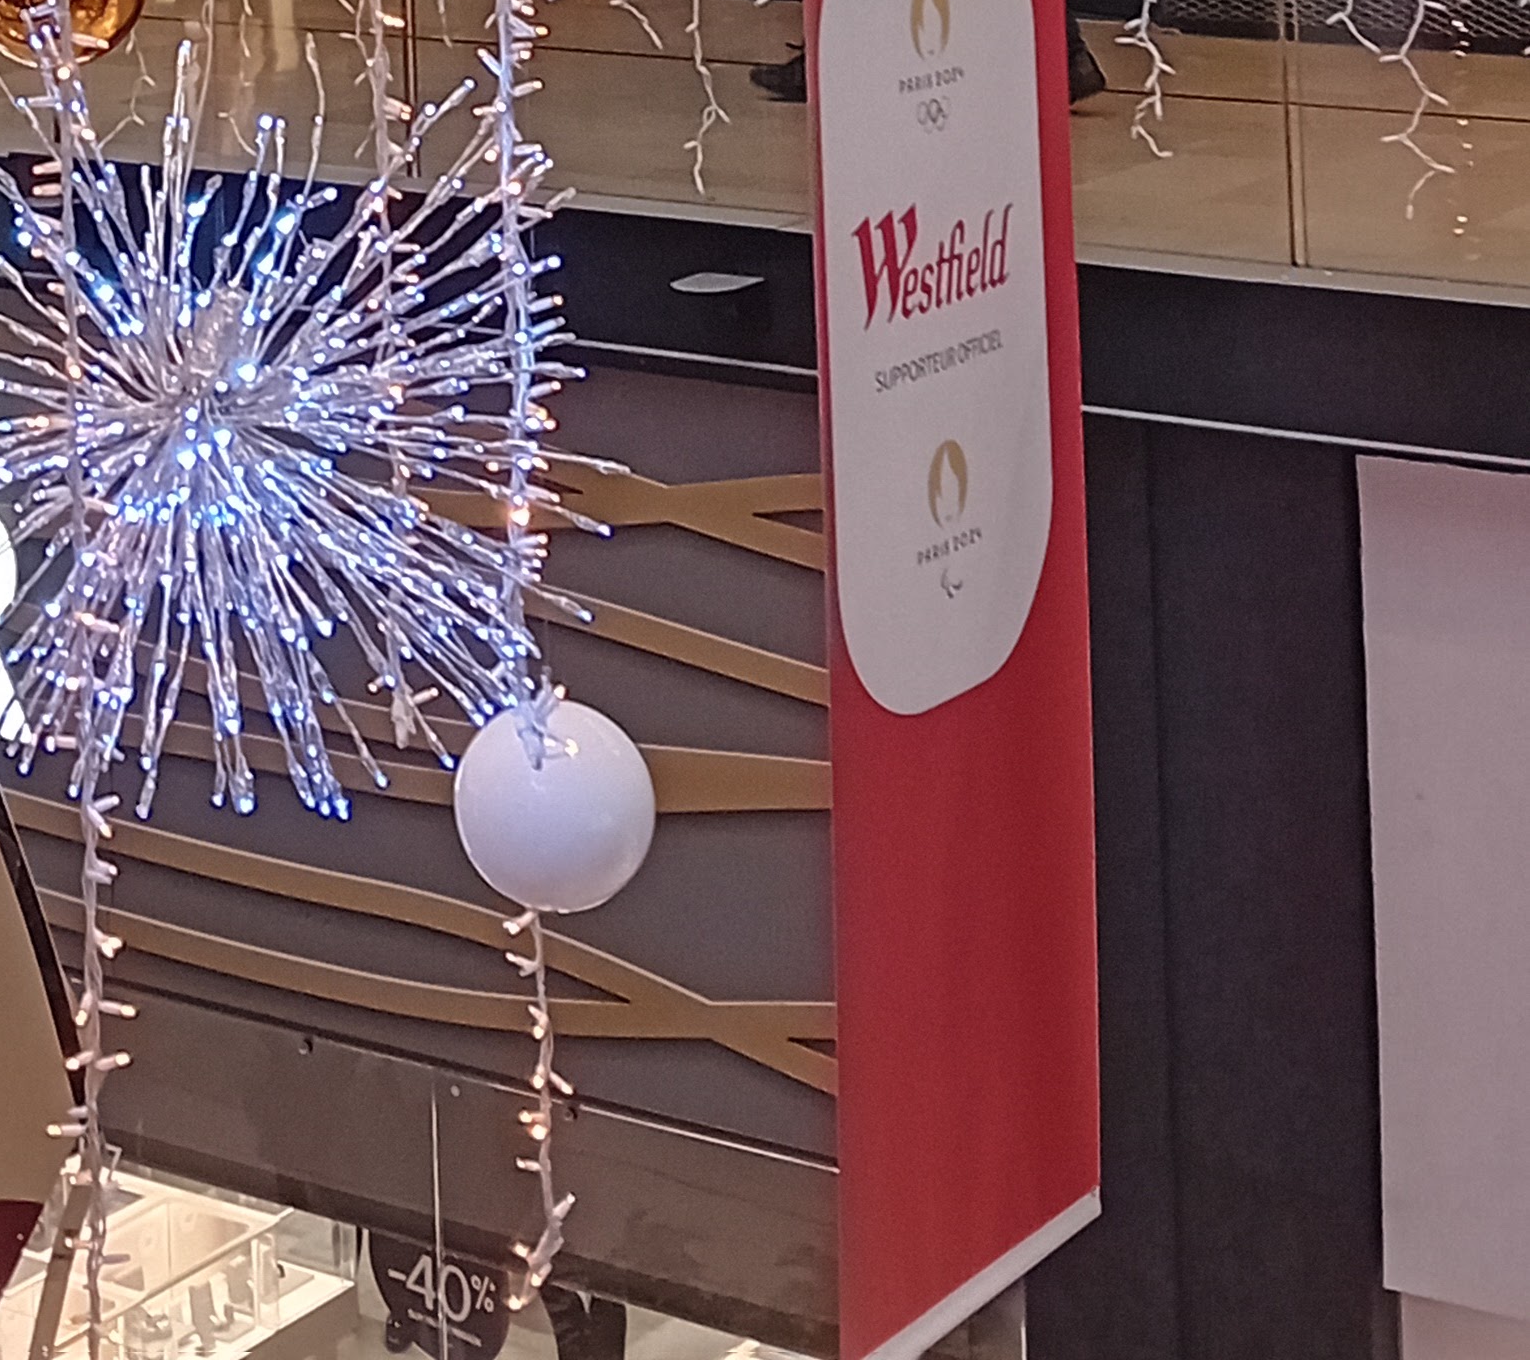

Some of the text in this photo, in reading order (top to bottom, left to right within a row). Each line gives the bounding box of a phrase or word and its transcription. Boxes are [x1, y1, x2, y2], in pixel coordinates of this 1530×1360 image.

[851, 203, 1013, 331] Westfield
[875, 329, 1004, 393] SUPPORTEUR OFFICIEL
[387, 1254, 495, 1323] -40%
